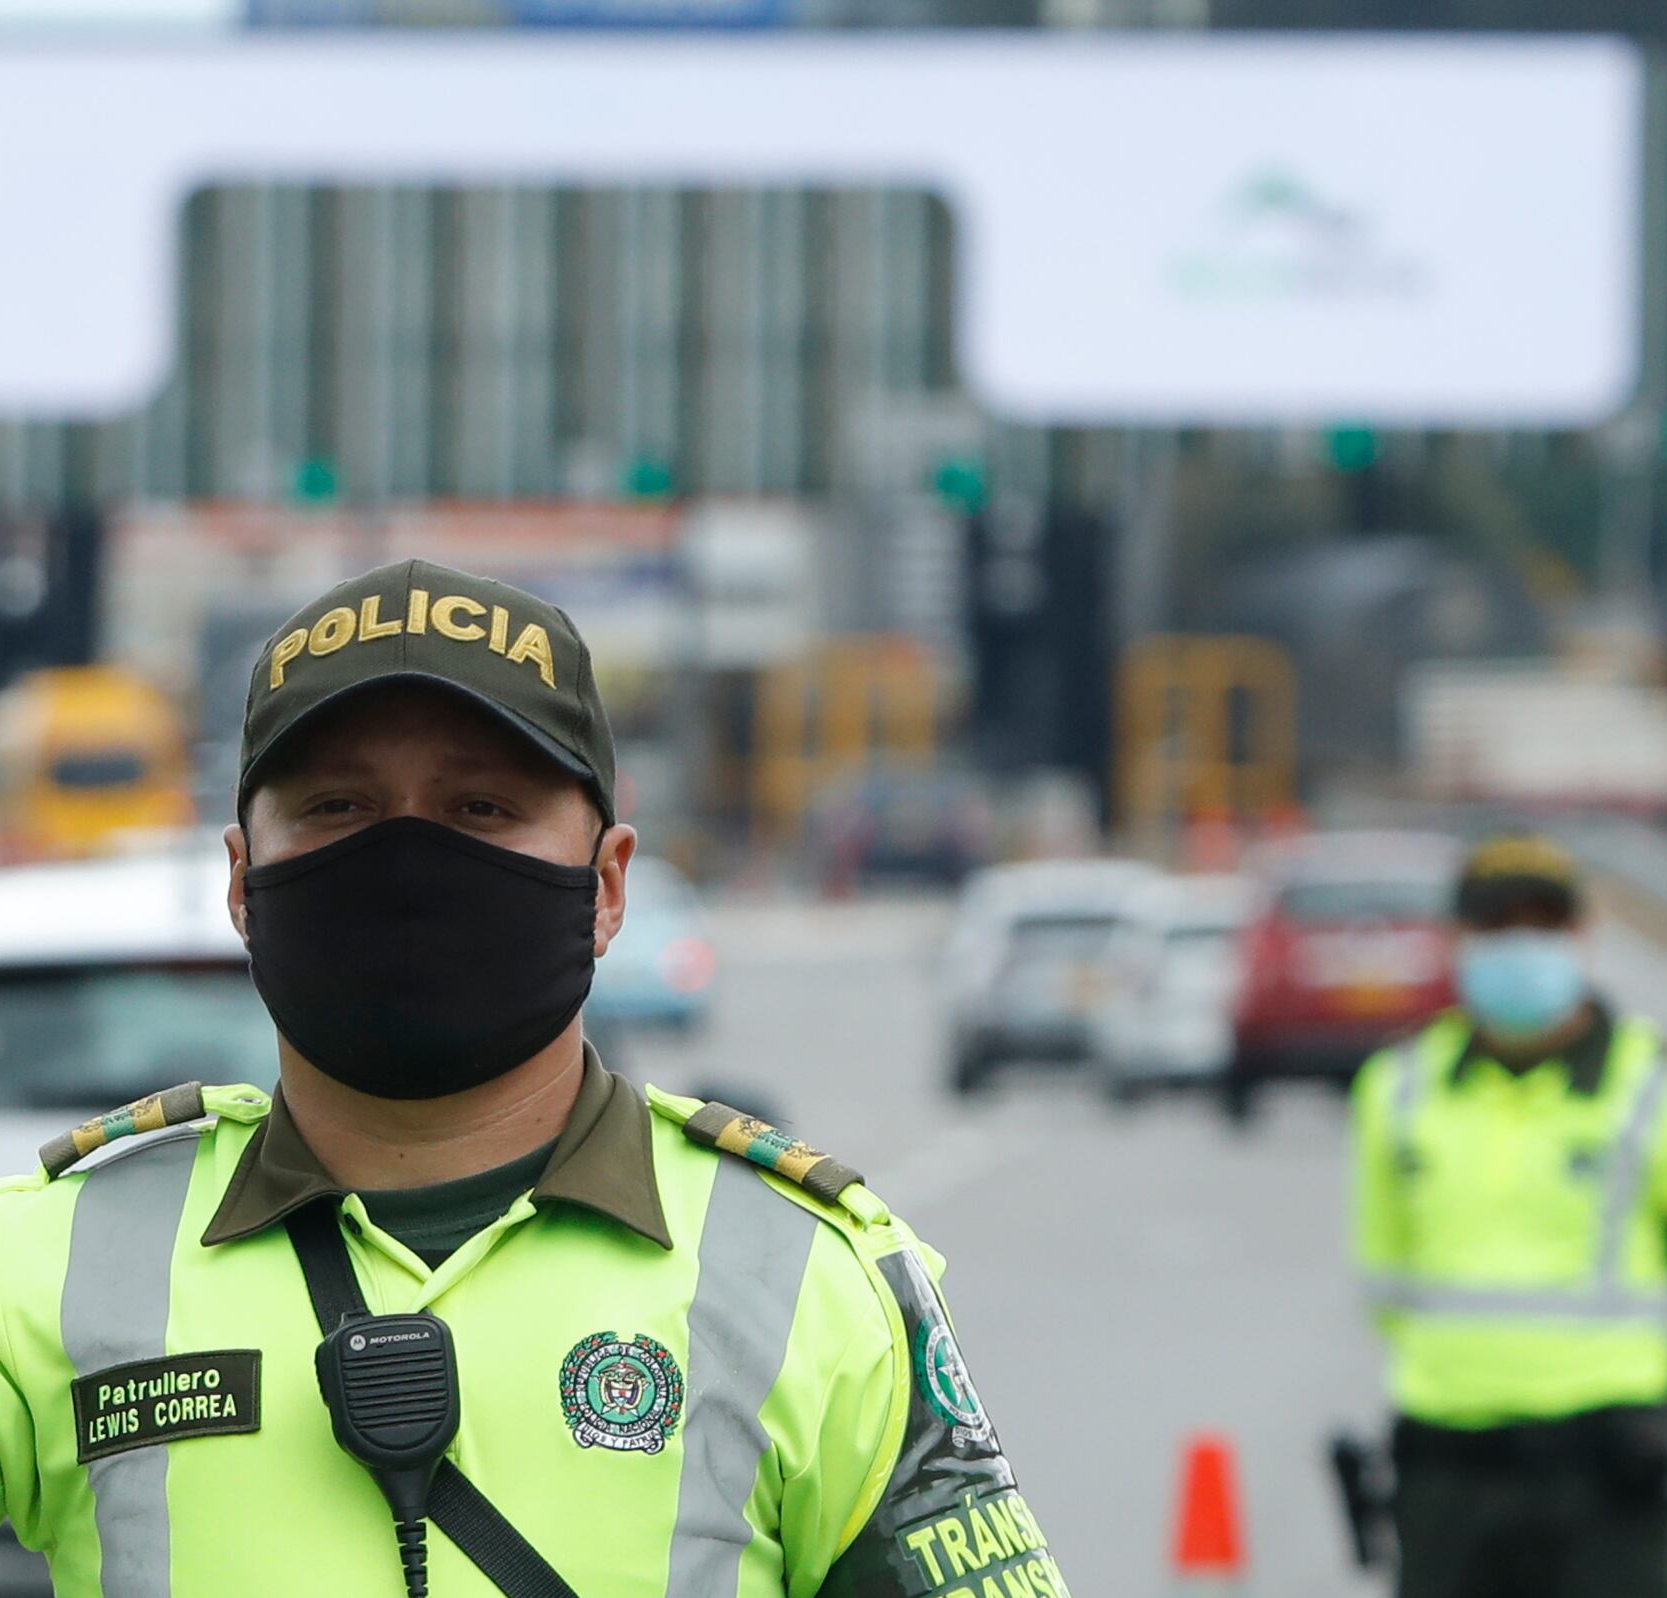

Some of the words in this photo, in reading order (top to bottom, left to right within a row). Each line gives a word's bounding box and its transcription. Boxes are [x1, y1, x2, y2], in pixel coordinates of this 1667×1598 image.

[269, 588, 557, 690] POLICIA
[369, 1331, 430, 1345] MOTOROLA
[98, 1368, 221, 1411] Patrullero
[88, 1407, 140, 1444] LEWIS
[154, 1394, 237, 1427] CORREA
